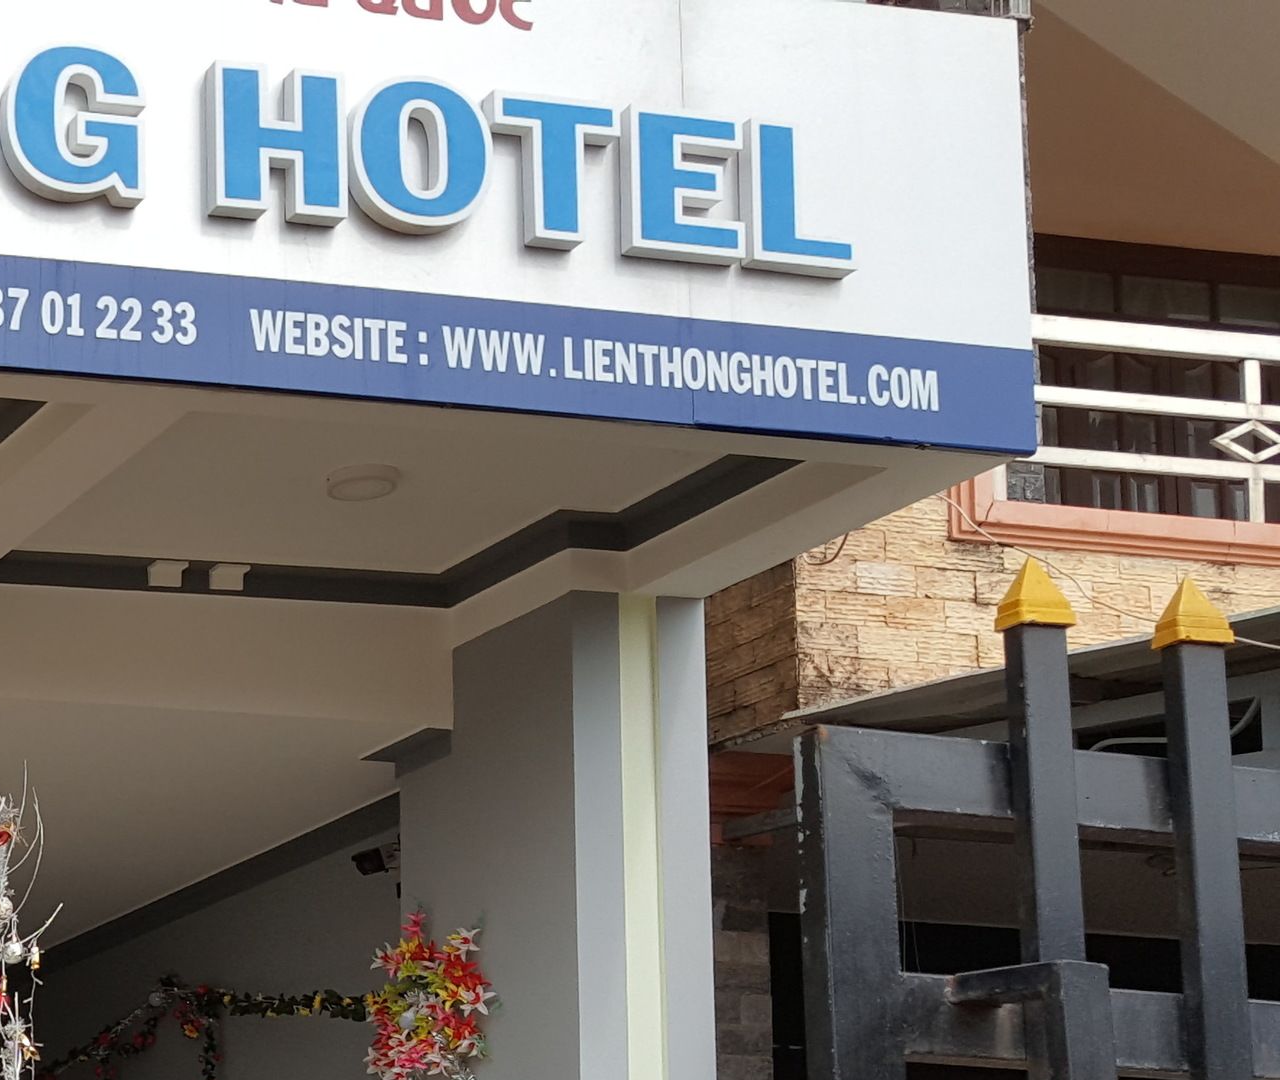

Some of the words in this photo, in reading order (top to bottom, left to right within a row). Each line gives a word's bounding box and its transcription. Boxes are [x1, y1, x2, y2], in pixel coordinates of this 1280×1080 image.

[204, 60, 858, 281] HOTEL
[41, 290, 85, 337] 01
[95, 295, 143, 341] 22
[151, 299, 198, 346] 33
